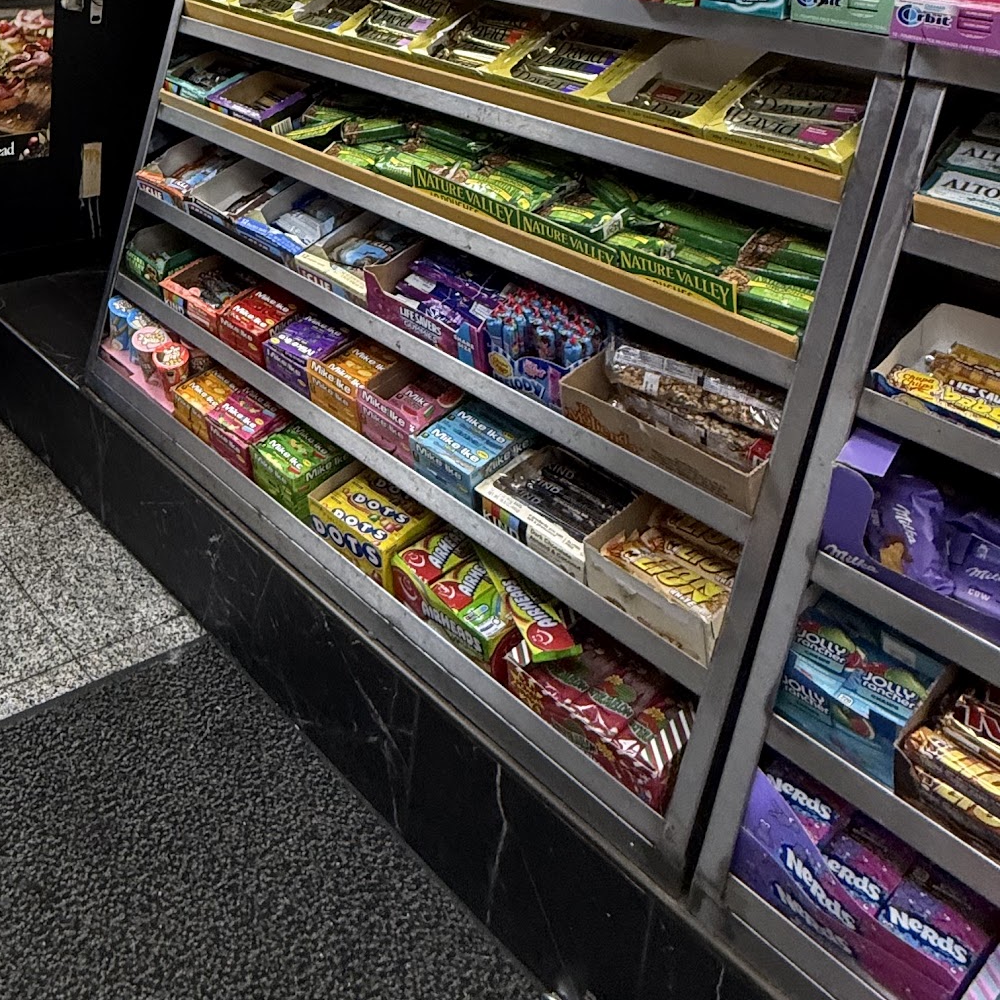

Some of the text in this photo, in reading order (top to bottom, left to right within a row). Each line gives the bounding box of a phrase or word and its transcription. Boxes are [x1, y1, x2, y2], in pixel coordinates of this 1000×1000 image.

[897, 4, 952, 27] Orbit
[731, 107, 800, 136] David
[757, 97, 827, 118] David
[416, 165, 516, 226] NATURE VALLEY
[522, 215, 615, 267] NATURE VALLEY
[307, 272, 331, 291] CLIF
[620, 249, 731, 306] NATURE VALLEY
[233, 305, 252, 320] Mike
[400, 307, 442, 336] LIFE SAVERS
[311, 361, 350, 394] Mike Ike
[903, 374, 934, 383] Chupa
[222, 403, 256, 428] Mike Ike
[362, 391, 405, 427] Mike Ike
[458, 411, 505, 444] Mike Ike
[269, 440, 302, 469] Mike Ike
[431, 428, 480, 463] Mike Ike
[306, 464, 332, 481] Mike
[352, 492, 409, 524] DOTS
[332, 508, 388, 541] DOTS
[896, 503, 916, 545] Milka
[311, 515, 382, 567] DOTS
[824, 543, 878, 572] Milka
[503, 579, 558, 628] AIRHEADS
[669, 588, 697, 607] WHITE
[422, 601, 482, 653] AIRHEADS
[800, 630, 847, 655] JOLLY
[864, 671, 916, 699] JOLLY
